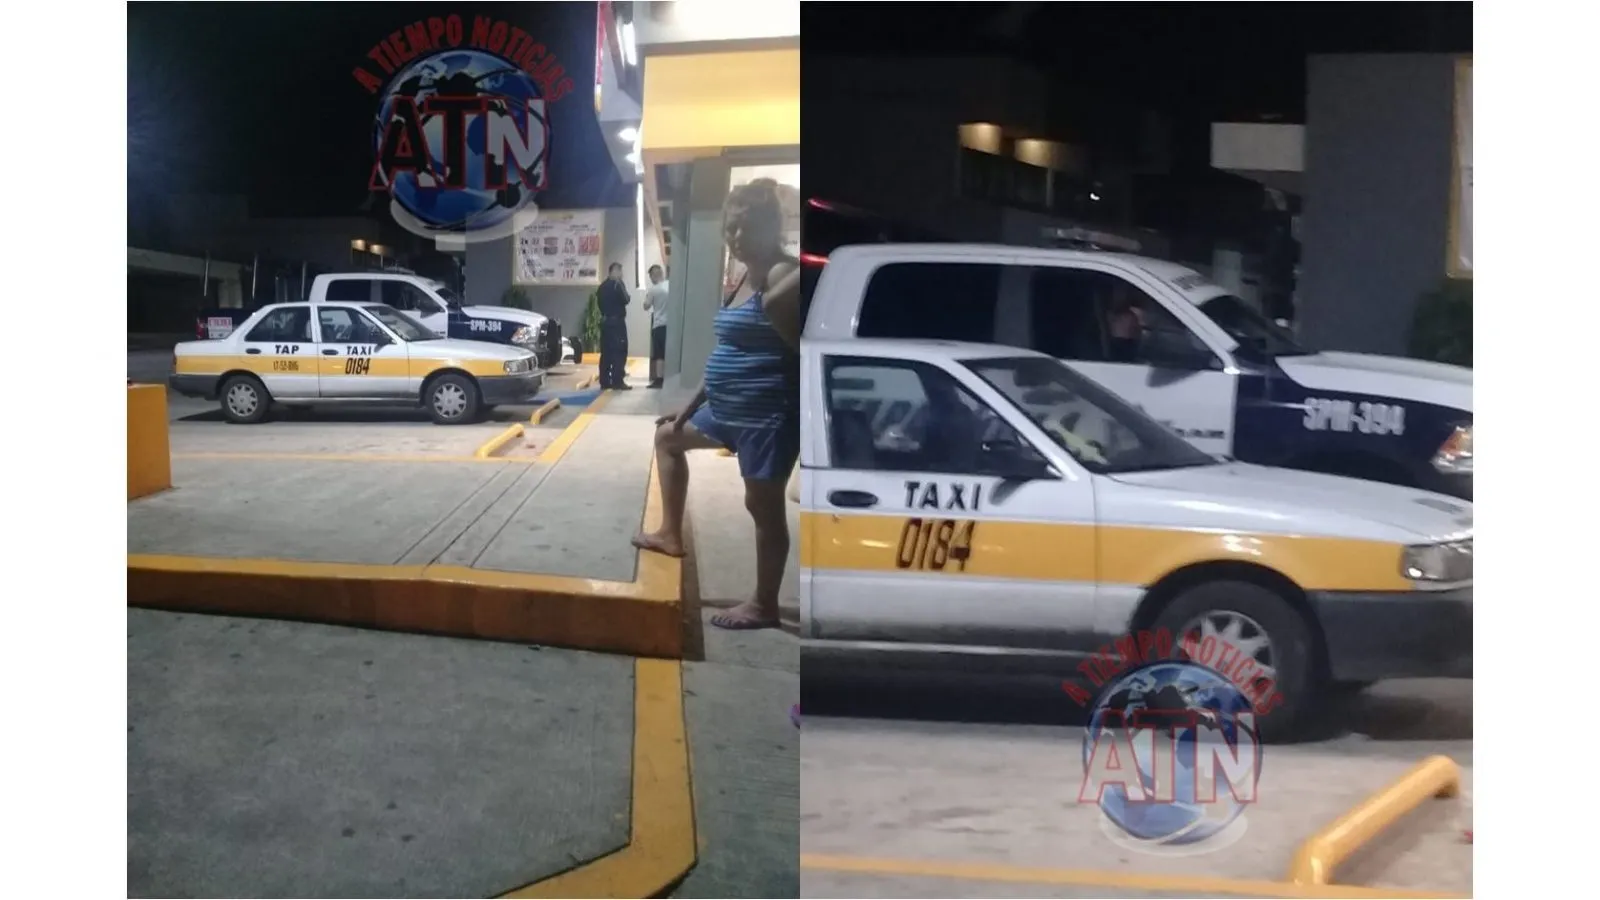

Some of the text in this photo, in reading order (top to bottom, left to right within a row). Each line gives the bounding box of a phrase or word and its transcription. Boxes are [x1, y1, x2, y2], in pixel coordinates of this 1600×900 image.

[470, 319, 502, 333] SPM-394
[275, 344, 300, 355] TAP
[346, 345, 372, 356] TAXI
[345, 357, 371, 375] 0184
[1303, 397, 1406, 436] SPM-394
[904, 479, 981, 512] TAXI
[896, 517, 975, 572] 0184
